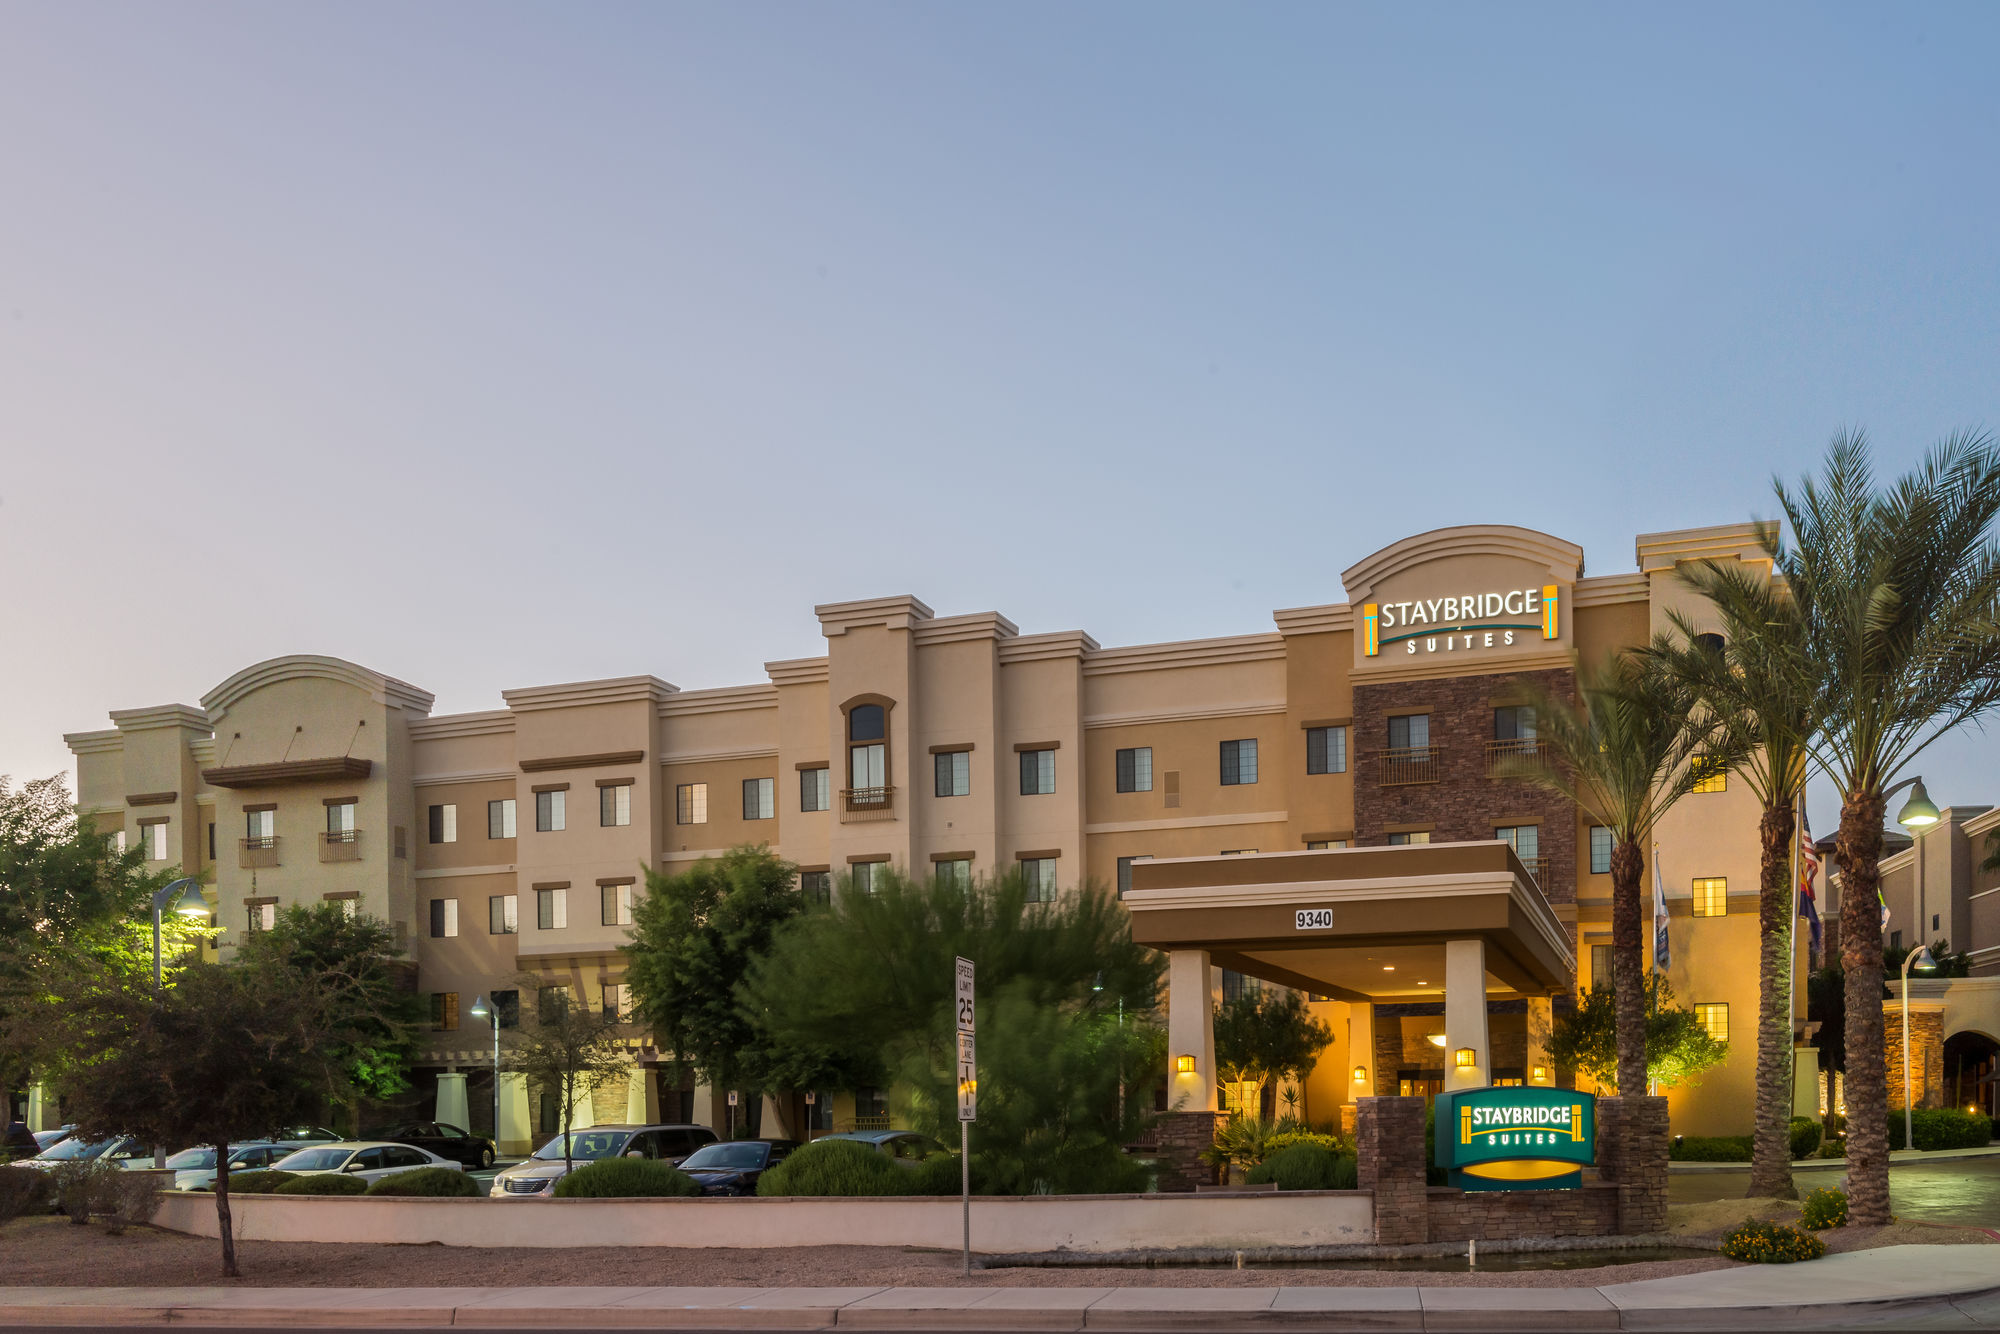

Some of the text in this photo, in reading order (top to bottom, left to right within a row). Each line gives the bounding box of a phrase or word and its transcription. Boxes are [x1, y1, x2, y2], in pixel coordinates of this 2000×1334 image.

[1382, 589, 1539, 628] STAYBRIDGE
[1407, 631, 1514, 655] SUITES
[1297, 911, 1331, 927] 9340
[958, 964, 973, 979] SPEED
[959, 980, 972, 994] LIMIT
[959, 997, 973, 1025] 25
[1473, 1107, 1571, 1125] STAYBRIDGE
[1488, 1133, 1556, 1145] SUITES
